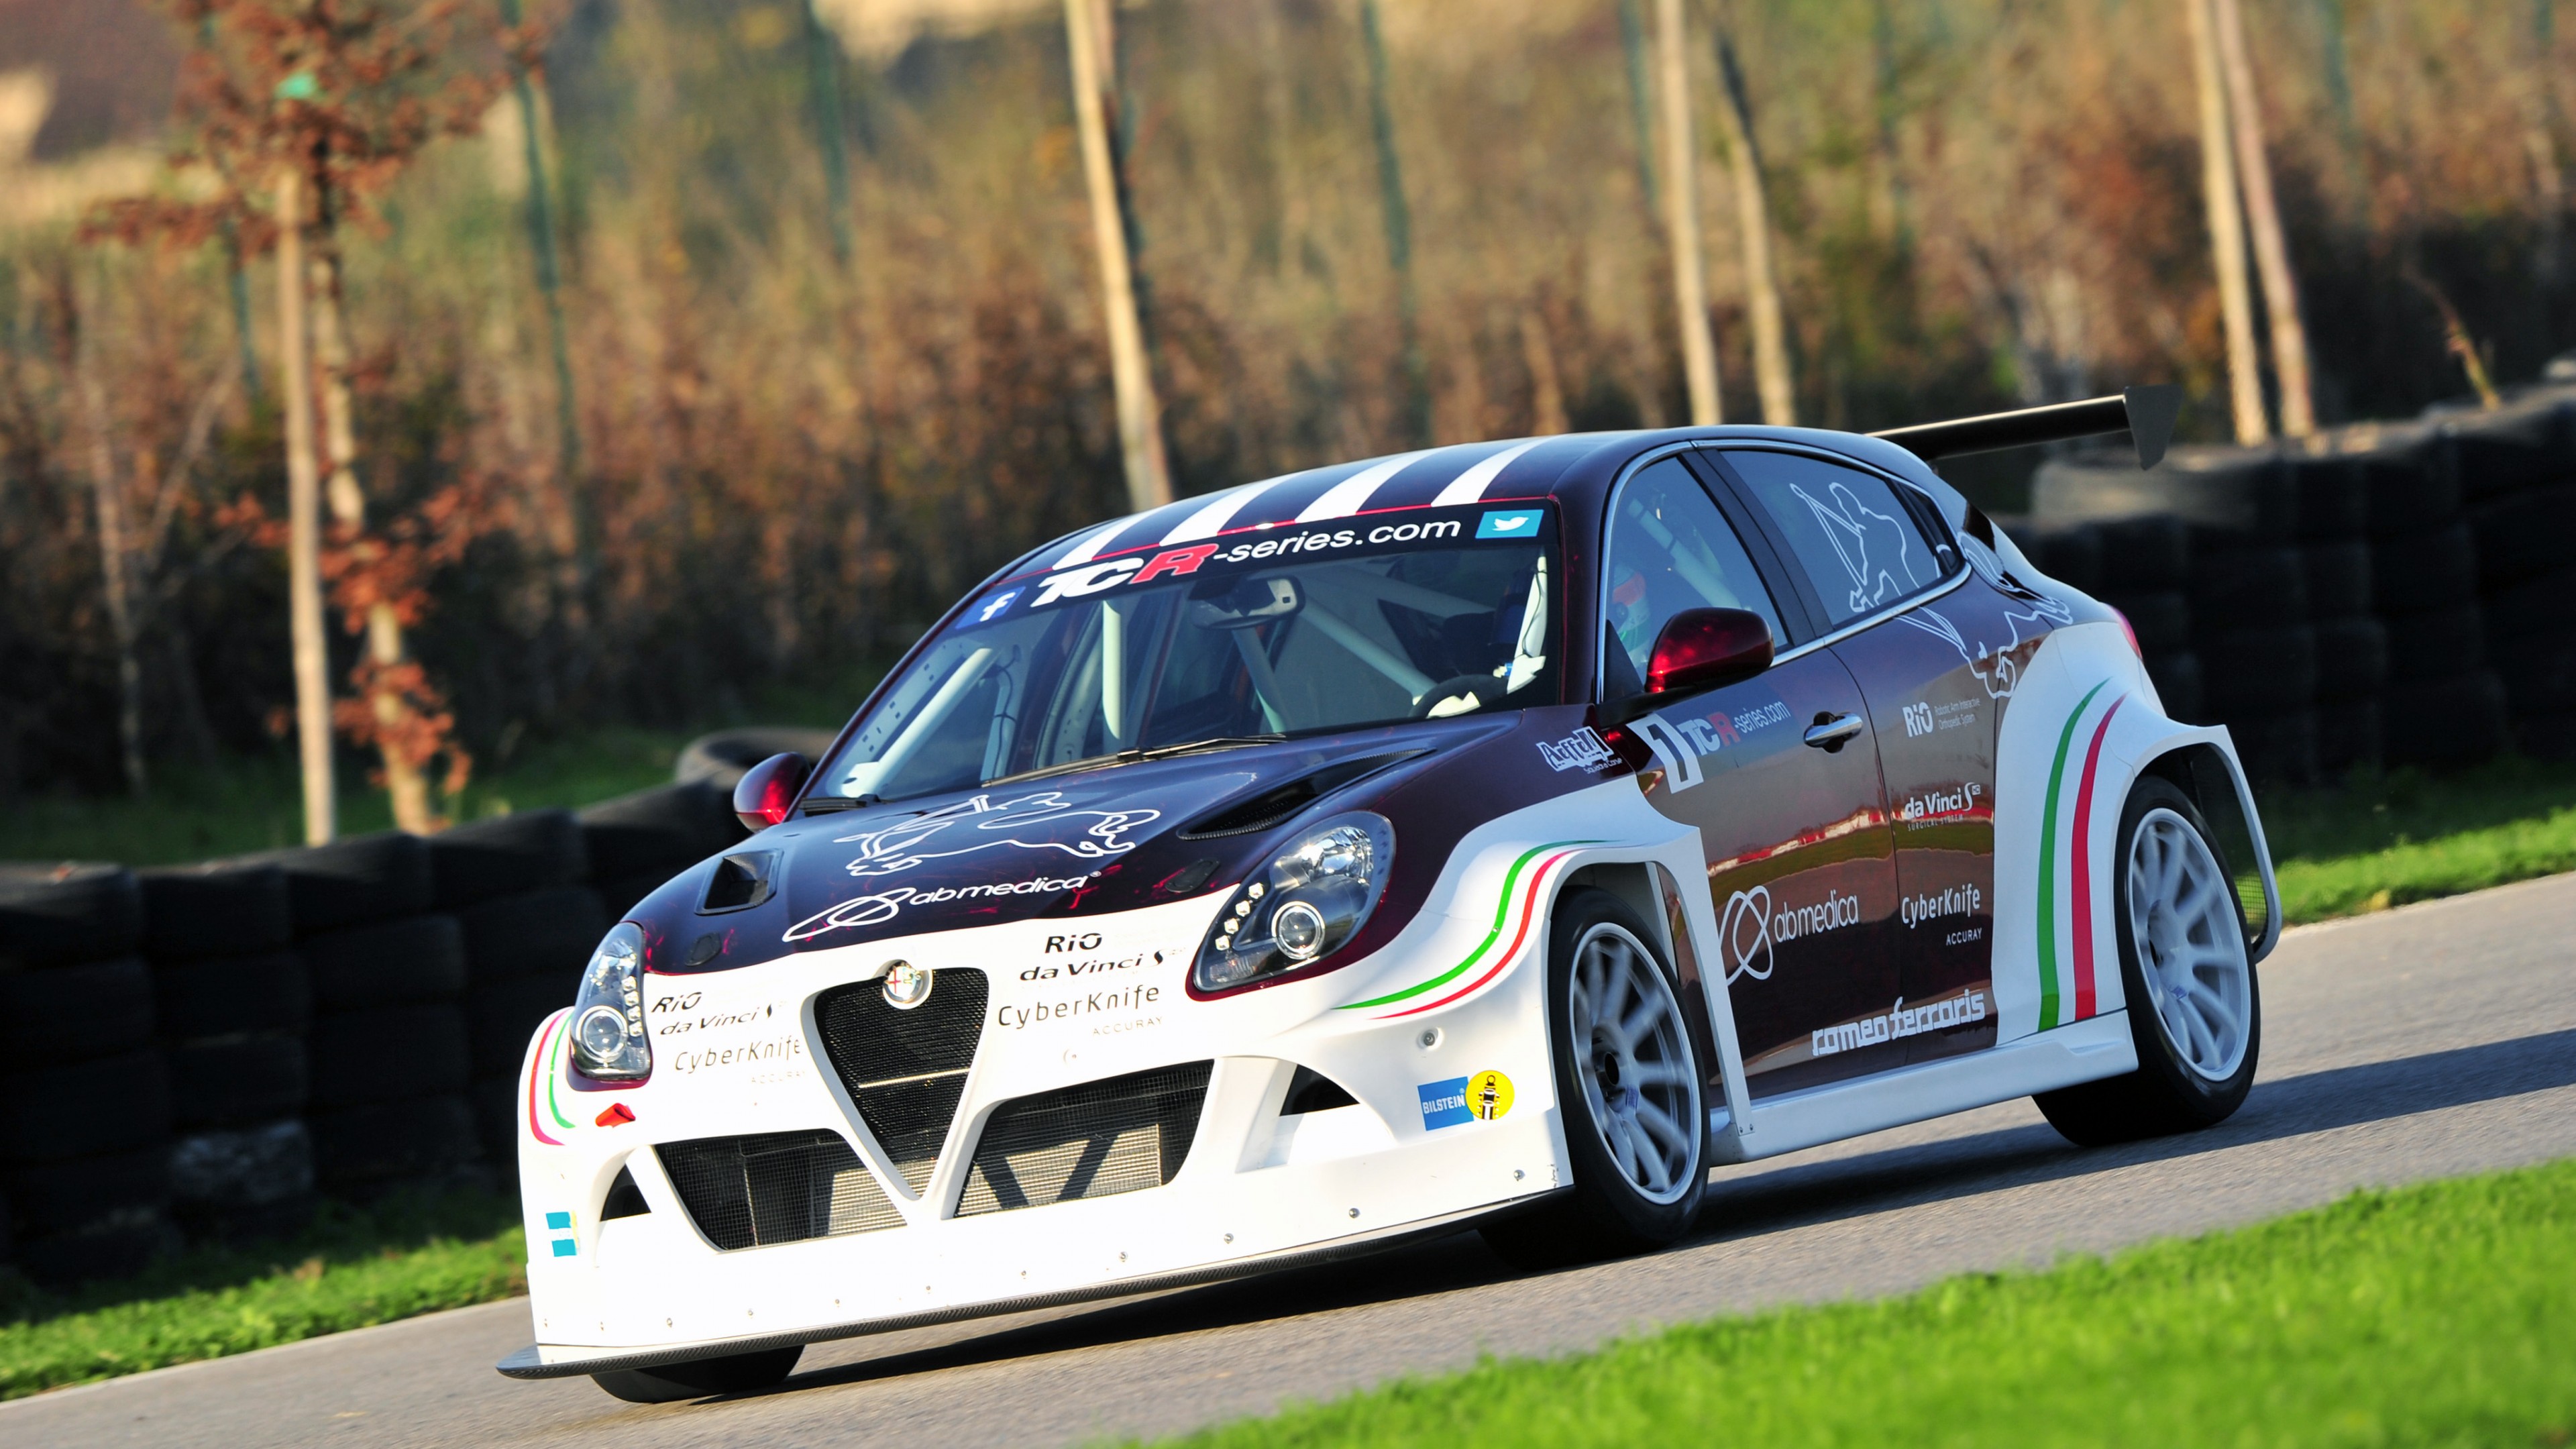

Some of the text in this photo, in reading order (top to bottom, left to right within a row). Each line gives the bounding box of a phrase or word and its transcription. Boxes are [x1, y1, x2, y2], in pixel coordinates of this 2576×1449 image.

[1904, 796, 1924, 820] da
[1924, 787, 1962, 814] Vinci
[1774, 889, 1860, 943] abmedica
[1902, 883, 1981, 928] CyberKnife
[1946, 927, 1983, 947] ACCURAY
[1020, 966, 1059, 981] da
[1067, 953, 1143, 975] Vinci
[660, 1022, 692, 1035] da
[700, 1007, 759, 1029] Vinci
[998, 984, 1160, 1030] CyberKnife
[1093, 1016, 1163, 1036] ACCURAY
[675, 1035, 801, 1075] CyberKnife
[1422, 1094, 1466, 1114] BILSTEIN
